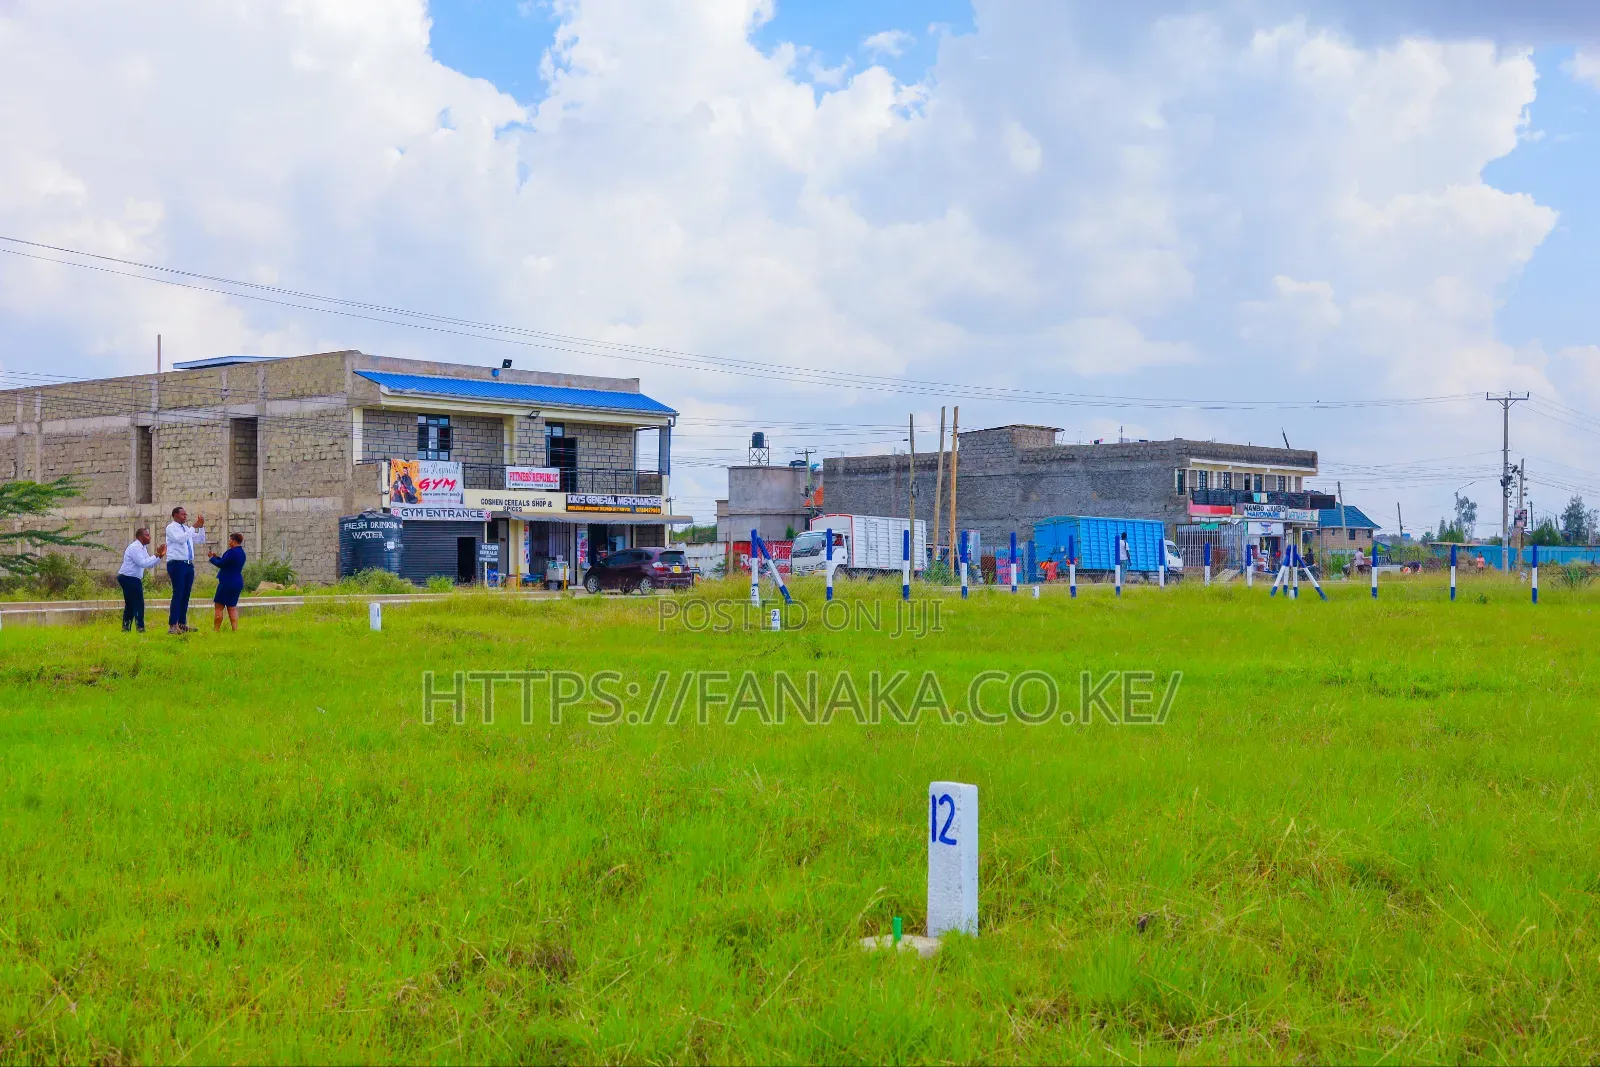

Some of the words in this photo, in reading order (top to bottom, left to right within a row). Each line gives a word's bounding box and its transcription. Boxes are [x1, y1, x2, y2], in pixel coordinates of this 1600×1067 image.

[509, 471, 531, 482] FITNESS
[532, 472, 559, 483] REPUBLIC
[418, 477, 457, 492] GYM
[480, 498, 503, 506] GOSHEN
[504, 499, 530, 507] CEREALS
[531, 500, 547, 508] SHOP
[567, 494, 586, 504] KIKI'S
[586, 495, 616, 505] GENERAL
[401, 508, 424, 518] GYM
[426, 509, 484, 518] ENTRANCE
[344, 521, 368, 530] FRESH
[351, 531, 384, 539] WATER
[931, 794, 957, 845] 12
